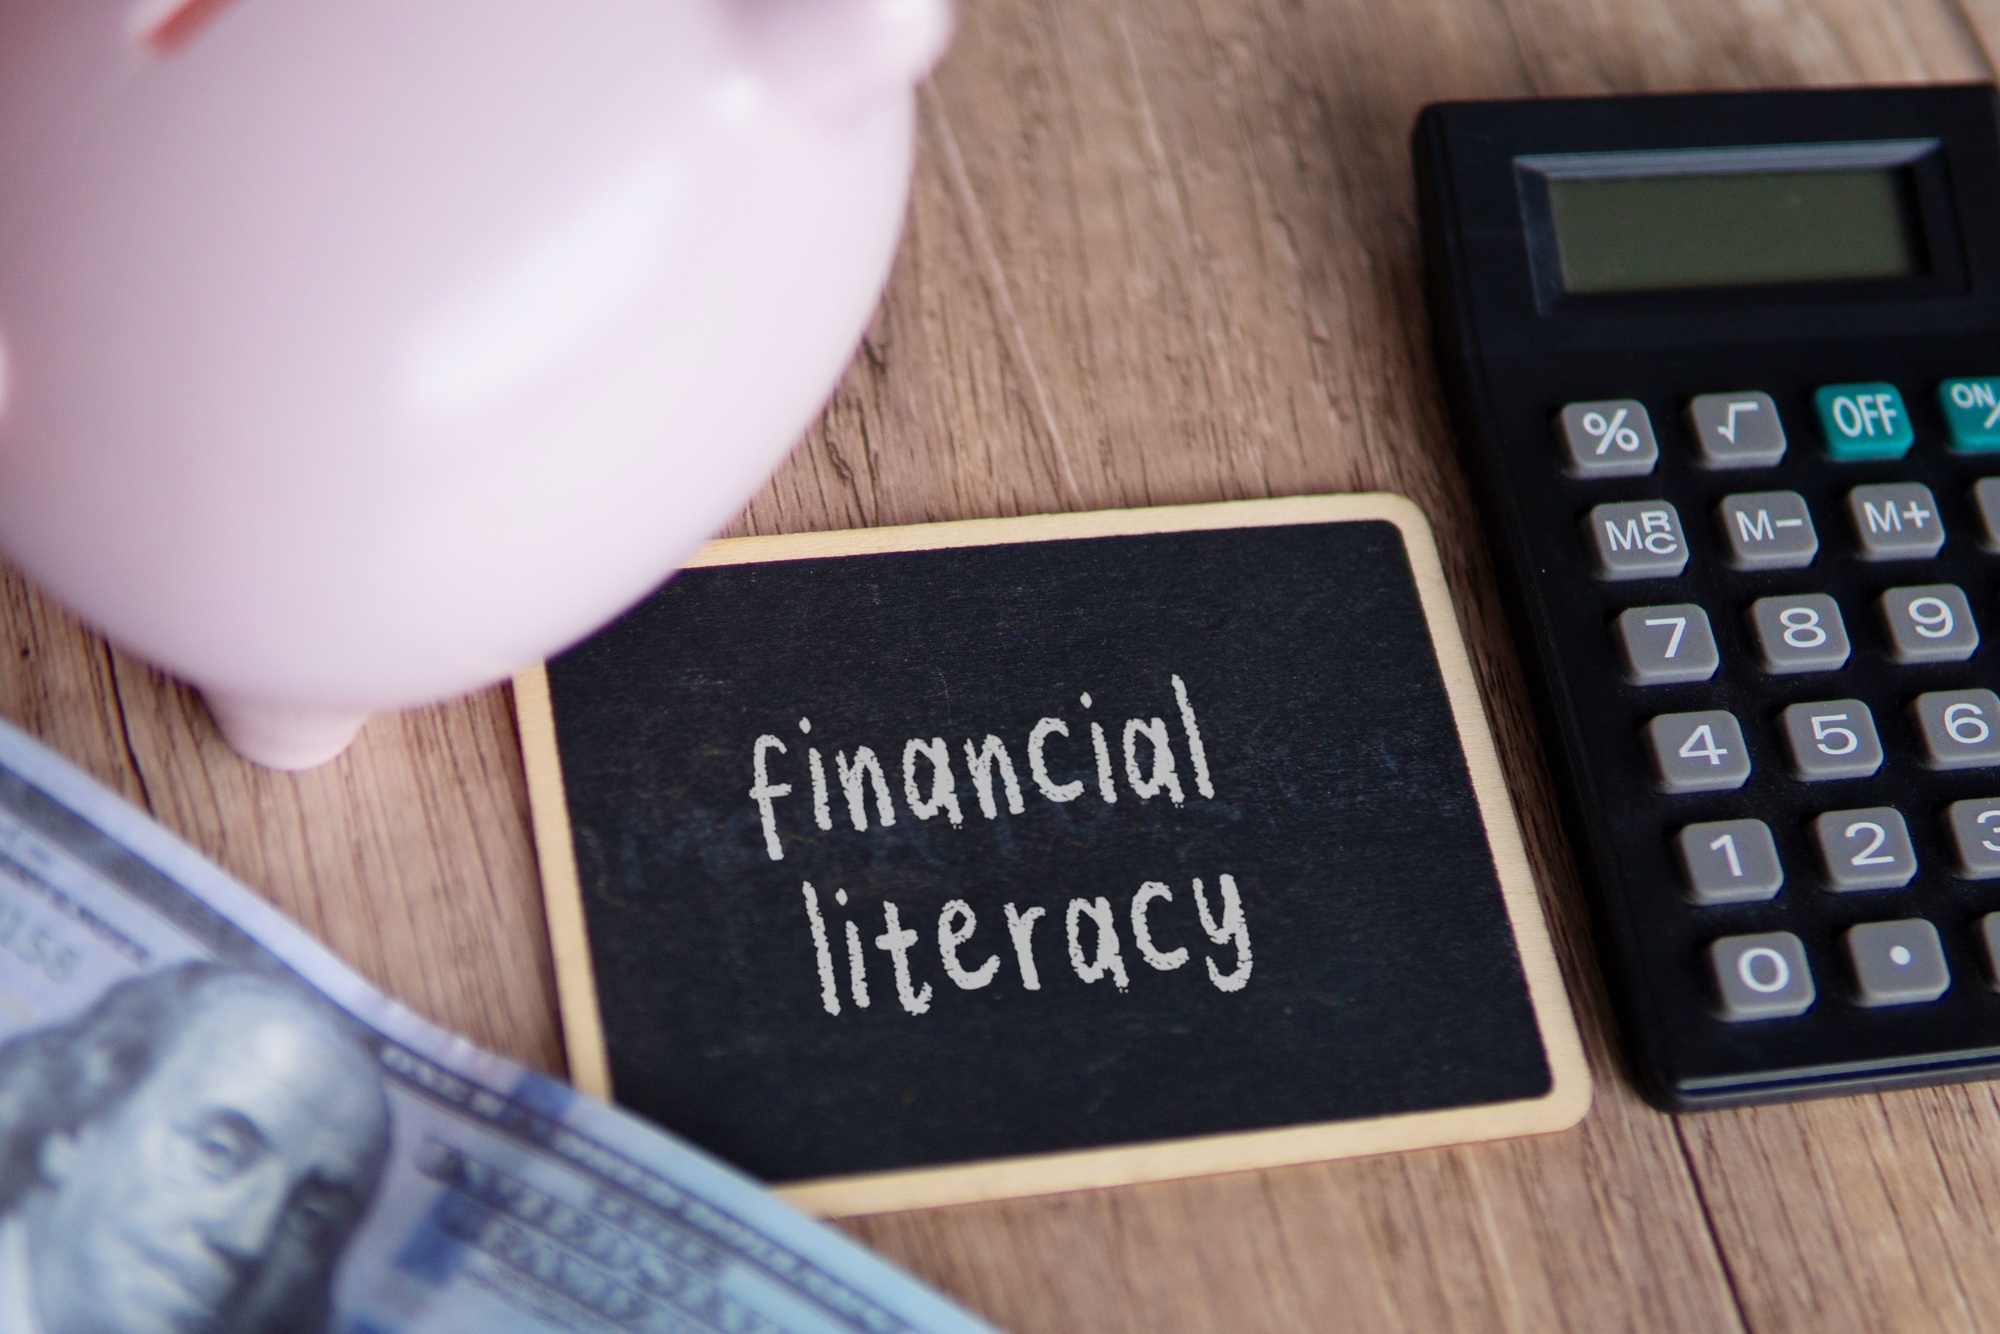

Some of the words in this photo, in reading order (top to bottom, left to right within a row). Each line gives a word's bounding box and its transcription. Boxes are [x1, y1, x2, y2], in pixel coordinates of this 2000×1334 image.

[1832, 394, 1897, 437] OFF
[1864, 499, 1931, 533] M+
[1645, 616, 1687, 659] 7
[1779, 607, 1827, 648] 8
[1907, 597, 1953, 639] 9
[1678, 724, 1728, 766] 4
[1810, 713, 1858, 756] 5
[1943, 703, 1989, 744] 6
[749, 673, 1215, 861] financial
[1709, 834, 1744, 878] 1
[1844, 821, 1895, 867] 2
[802, 873, 1254, 1017] literacy
